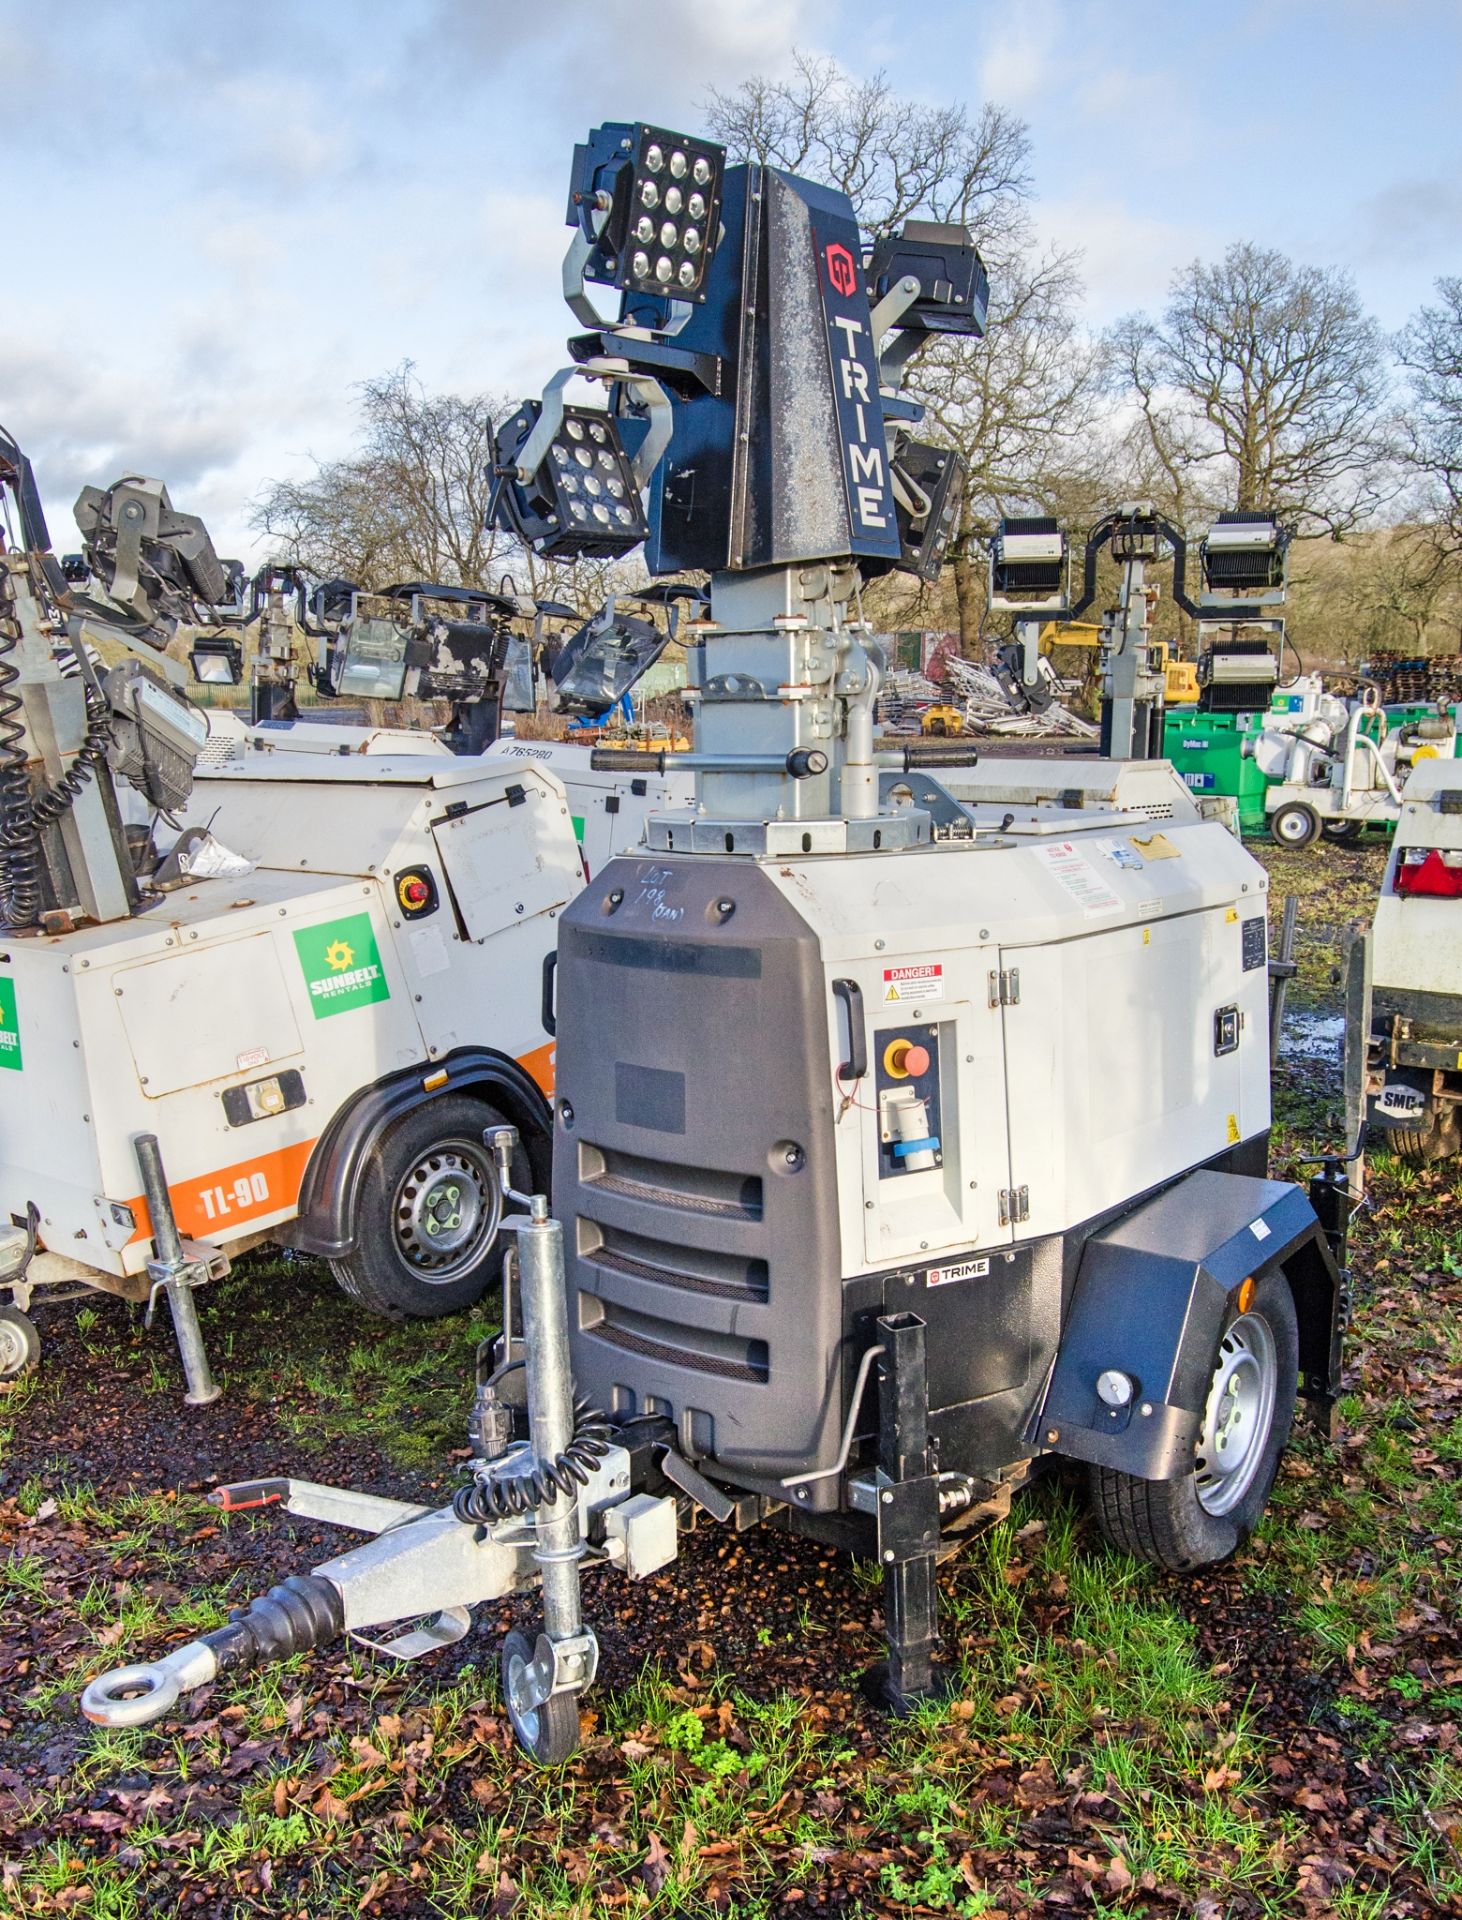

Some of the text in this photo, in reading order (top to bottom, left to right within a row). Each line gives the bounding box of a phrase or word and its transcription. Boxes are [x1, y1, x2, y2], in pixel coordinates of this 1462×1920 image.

[835, 316, 886, 528] TRIME
[634, 888, 665, 906] 198
[310, 965, 379, 996] SUNBELT
[891, 966, 935, 980] DANGER!
[323, 980, 372, 999] RENTALS
[199, 1172, 269, 1219] TL-90
[942, 1262, 986, 1279] TRIME
